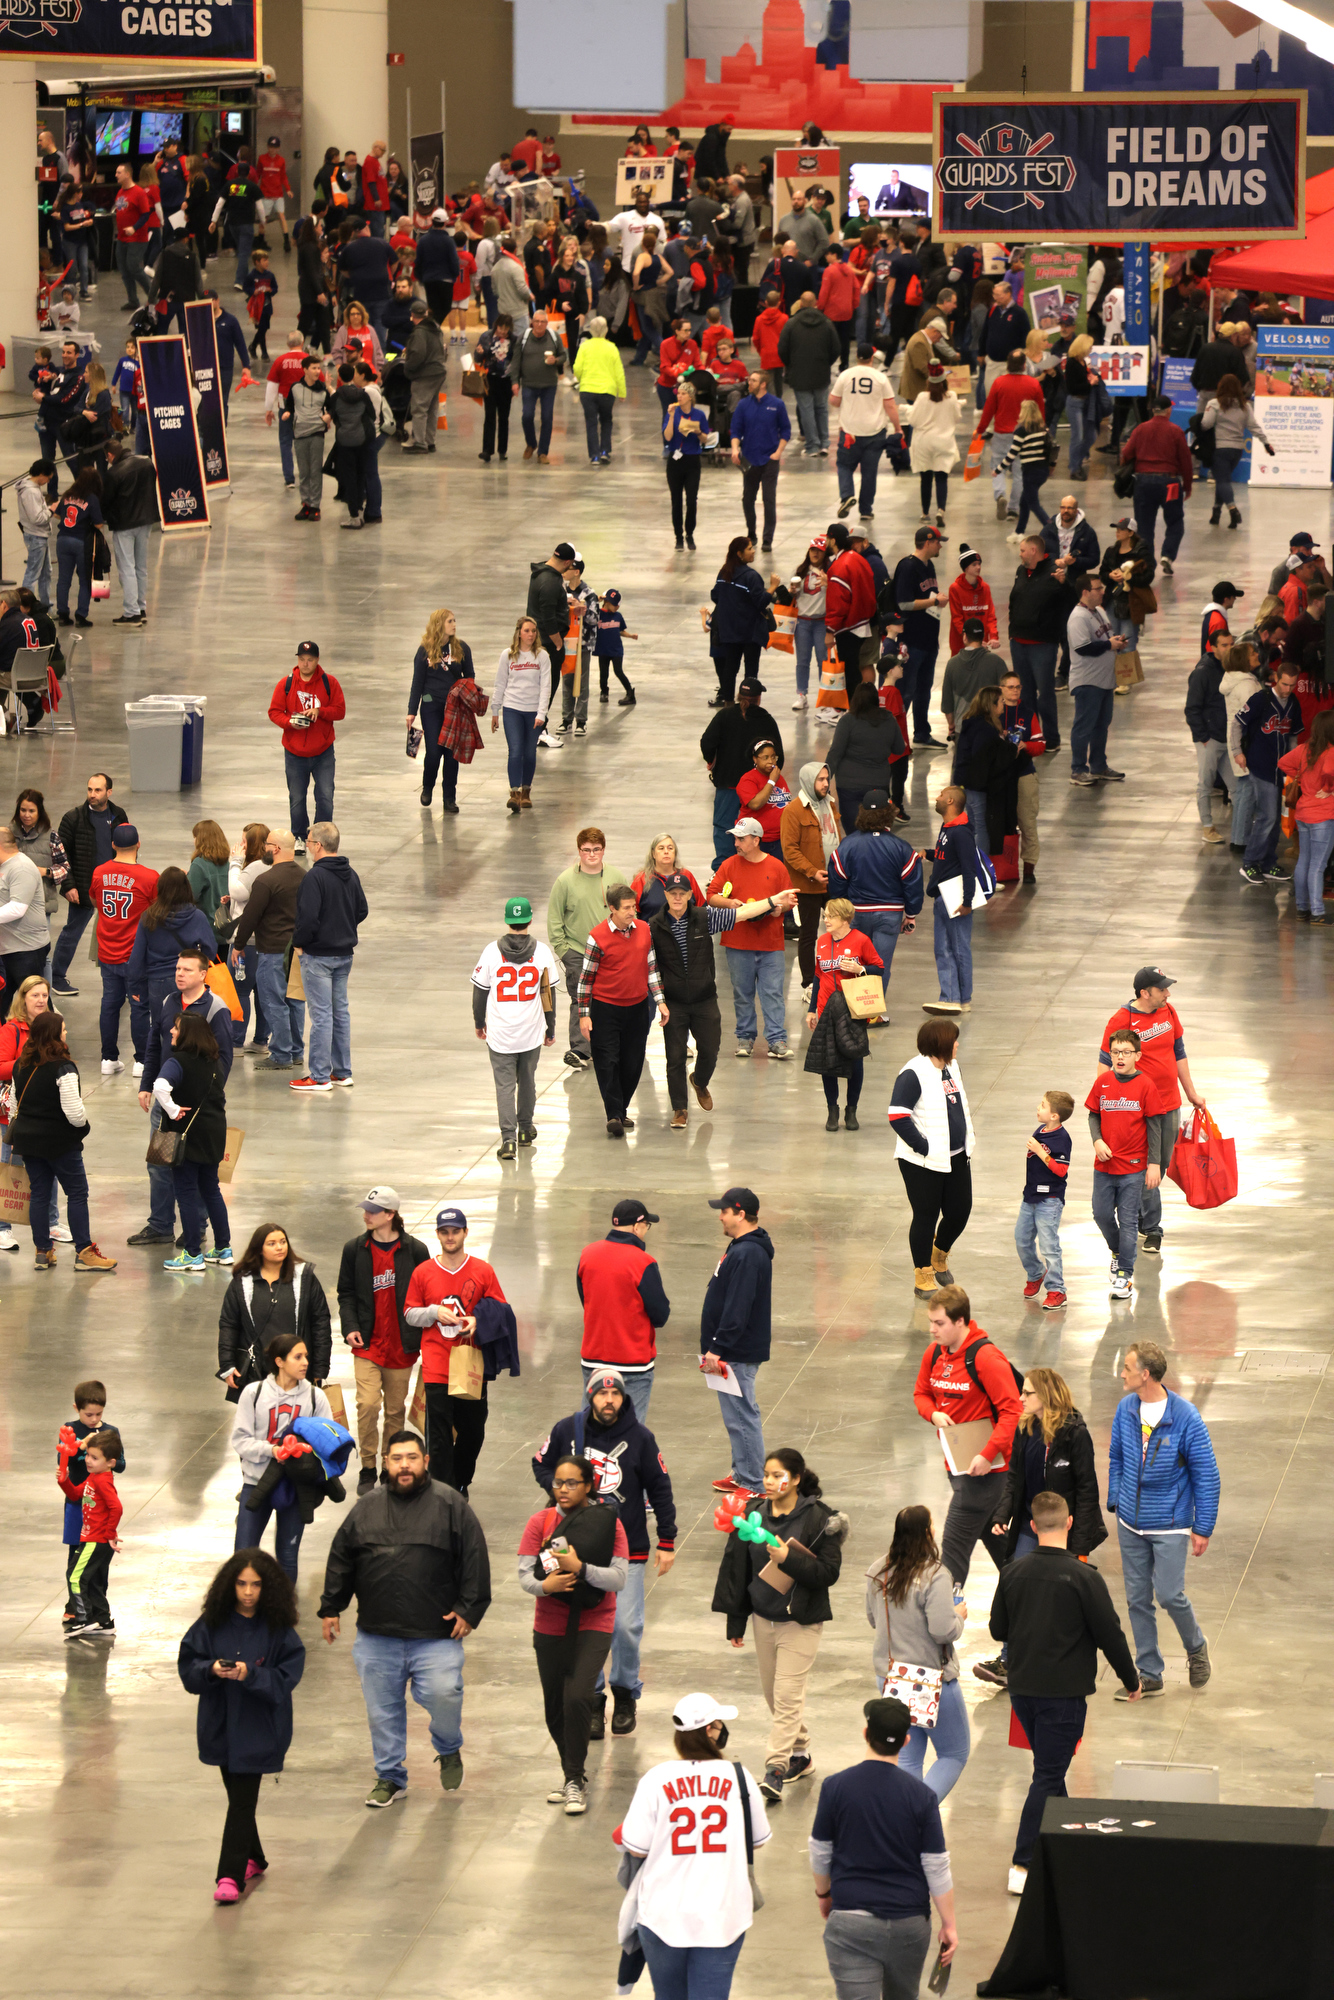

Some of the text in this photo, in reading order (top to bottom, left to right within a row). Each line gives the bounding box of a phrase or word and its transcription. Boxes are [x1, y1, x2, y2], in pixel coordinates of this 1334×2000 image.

[39, 0, 73, 18] FEST
[121, 6, 213, 38] CAGES
[997, 128, 1013, 153] C
[1107, 125, 1268, 163] FIELD OF
[945, 162, 1065, 187] GUARDS FEST
[1107, 168, 1267, 207] DREAMS
[1264, 333, 1331, 345] VELOSANO
[195, 368, 214, 381] PITCHING
[198, 380, 212, 392] CAGES
[850, 377, 873, 394] 19
[153, 405, 185, 418] PITCHING
[160, 417, 182, 430] CAGES
[64, 505, 78, 528] 9
[21, 618, 40, 649] C
[509, 661, 541, 672] Guardians
[102, 873, 135, 890] BIEBER
[673, 875, 681, 884] C
[102, 890, 133, 919] 57
[513, 905, 522, 917] C
[496, 966, 539, 1003] 22
[1099, 1095, 1141, 1111] Guardians
[368, 1190, 379, 1200] C
[3, 1198, 24, 1211] GEAR
[941, 1364, 953, 1378] C
[603, 1376, 614, 1388] C
[930, 1378, 970, 1391] ARDIANS
[662, 1775, 733, 1805] NAYLOR
[669, 1804, 728, 1856] 22
